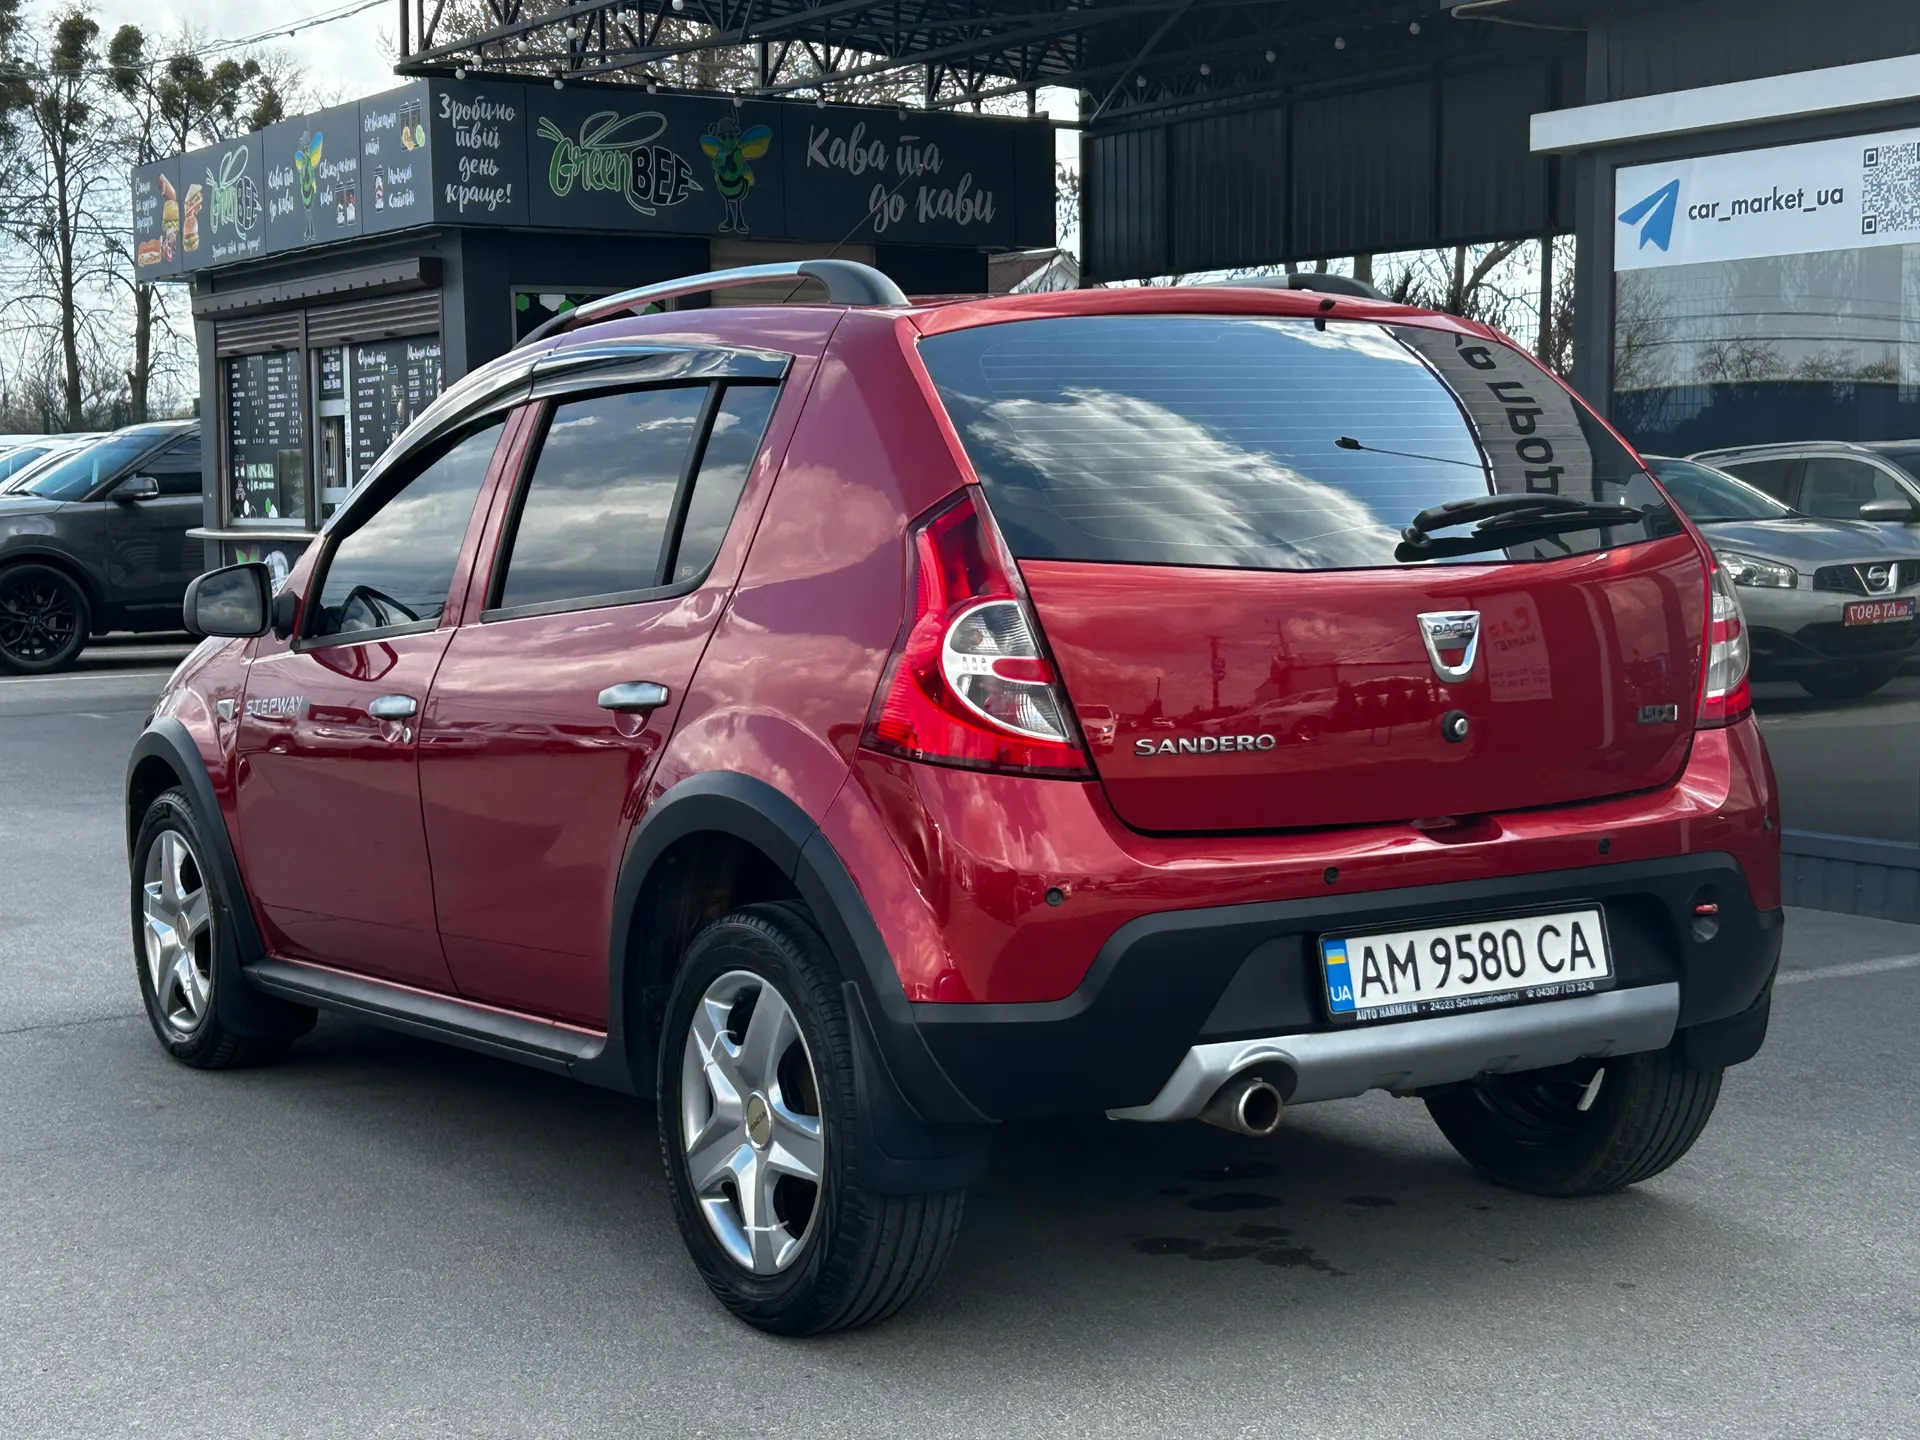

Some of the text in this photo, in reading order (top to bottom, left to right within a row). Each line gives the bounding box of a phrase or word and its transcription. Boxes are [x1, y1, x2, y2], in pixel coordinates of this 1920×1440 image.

[439, 93, 516, 128] Зробимо
[455, 121, 501, 149] твій
[806, 121, 943, 177] Кава та
[458, 156, 500, 182] день
[444, 183, 513, 213] краще!
[869, 172, 996, 233] до кави
[1688, 186, 1844, 222] car_market_ua
[246, 696, 304, 715] STEPWAY
[1134, 733, 1276, 756] SANDERO
[1360, 921, 1597, 998] AM 9580 CA
[1330, 985, 1353, 1002] UA
[1356, 1006, 1377, 1021] AUTO
